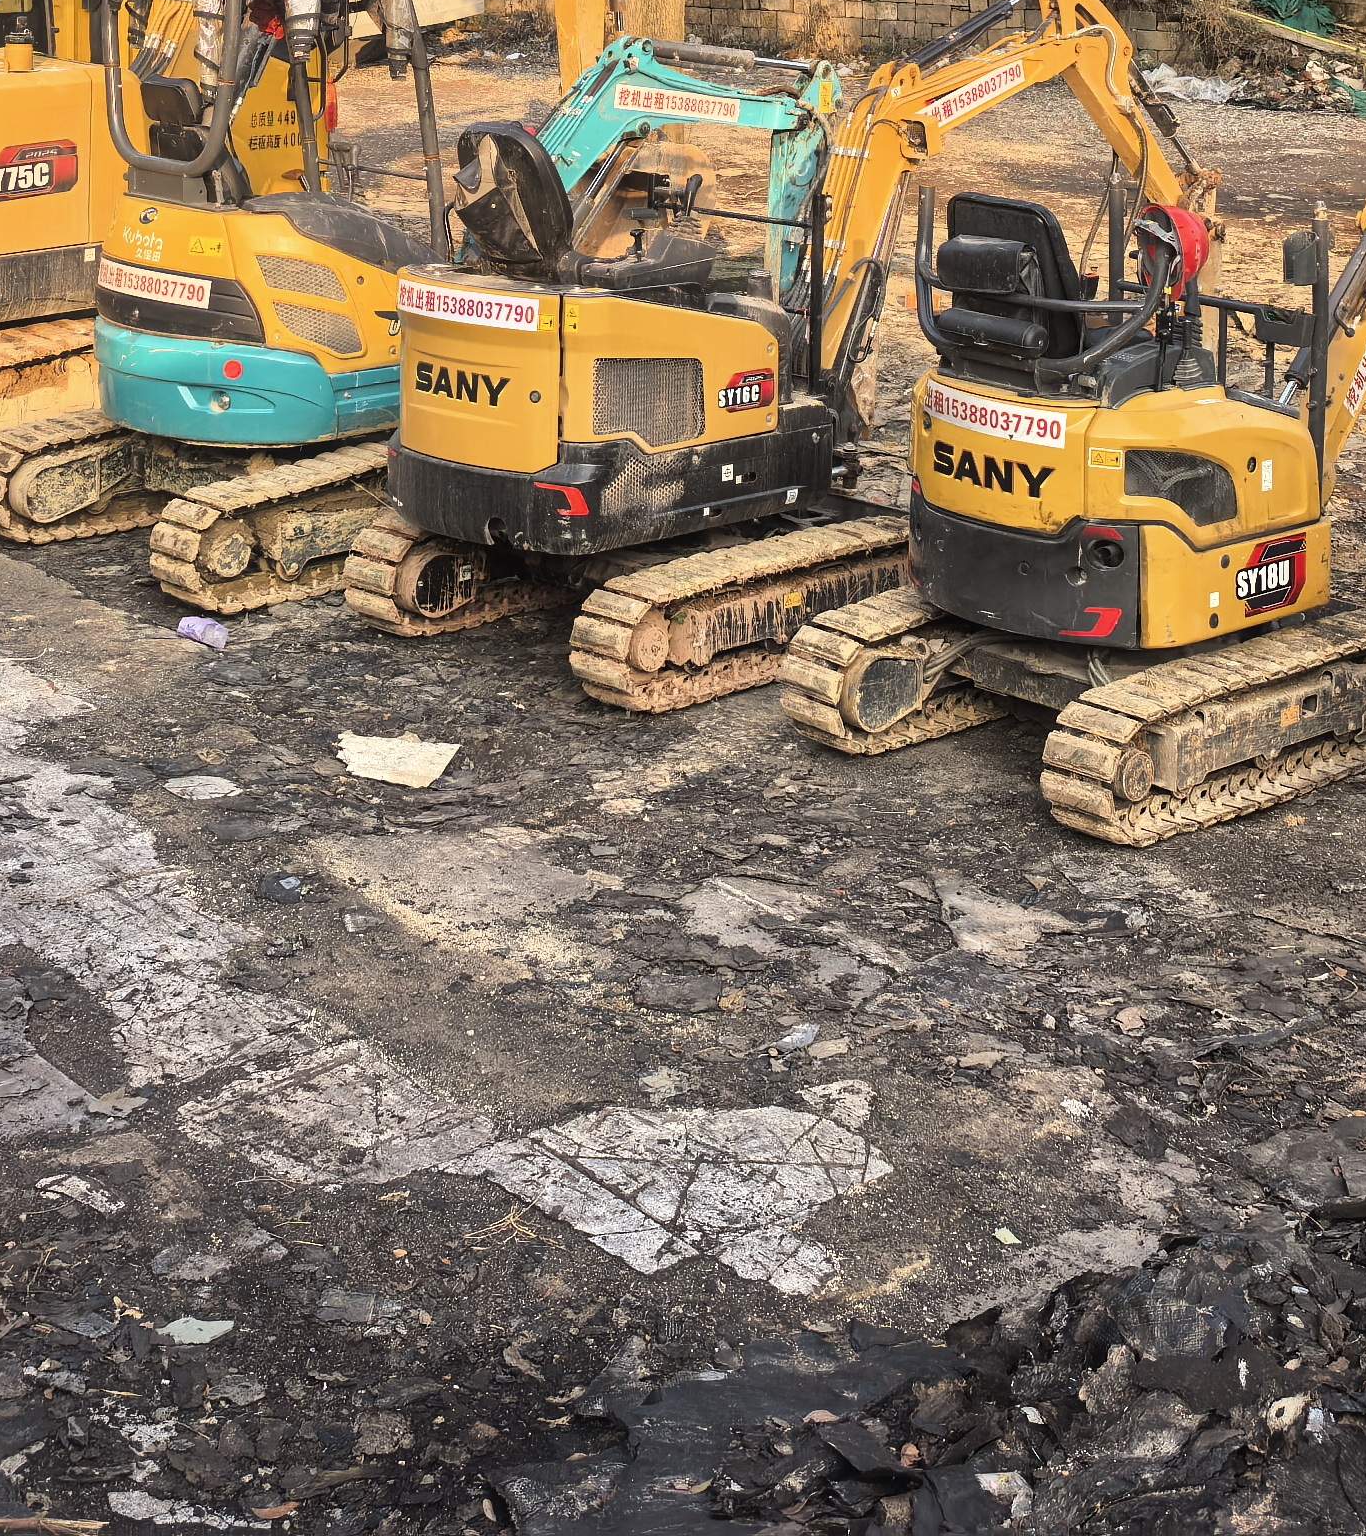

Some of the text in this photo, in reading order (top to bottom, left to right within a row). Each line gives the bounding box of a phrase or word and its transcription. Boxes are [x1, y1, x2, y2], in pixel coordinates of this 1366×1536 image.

[618, 87, 736, 117] 挖机出租15388037790
[123, 225, 163, 250] Kubota
[399, 284, 535, 324] 挖机出租15388037790
[415, 361, 511, 407] SANY
[718, 384, 760, 408] SY16C
[933, 440, 1055, 498] SANY
[1237, 559, 1290, 598] SY18U
